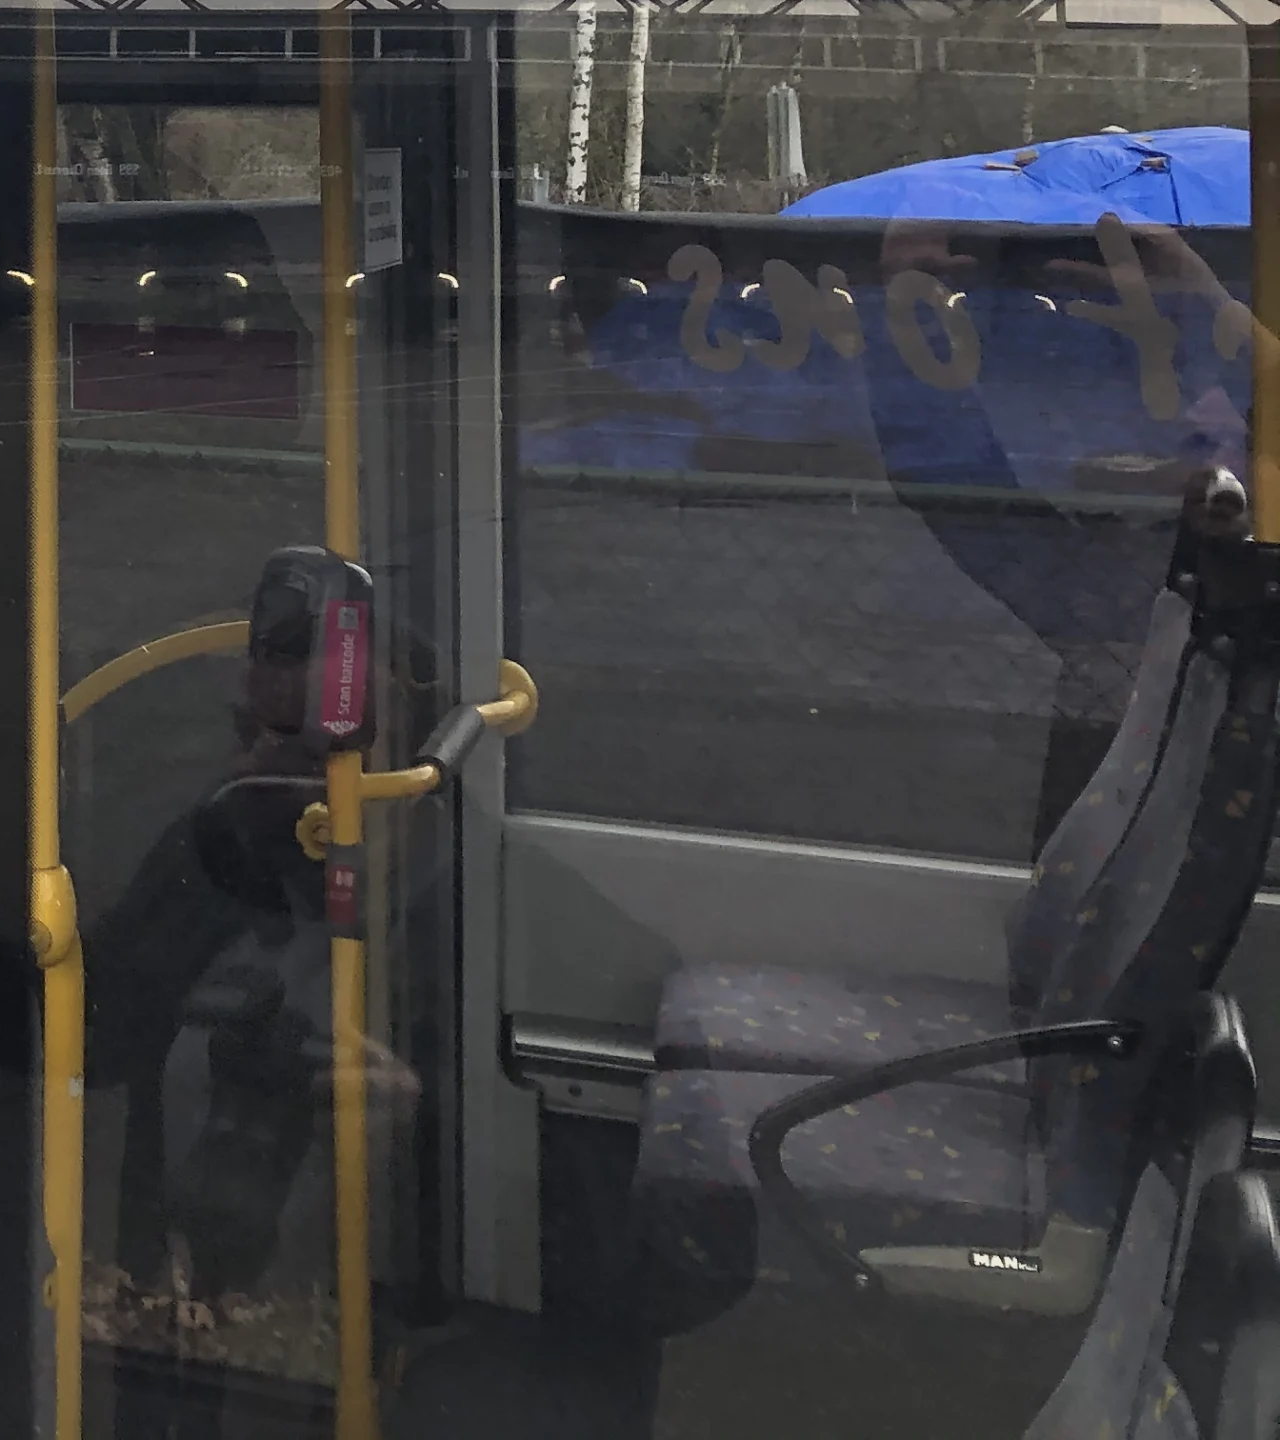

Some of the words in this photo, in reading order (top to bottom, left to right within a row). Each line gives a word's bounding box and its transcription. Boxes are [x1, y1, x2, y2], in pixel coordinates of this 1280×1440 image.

[339, 633, 355, 685] barcode
[337, 686, 352, 716] Scan
[971, 1252, 1019, 1270] MAN
